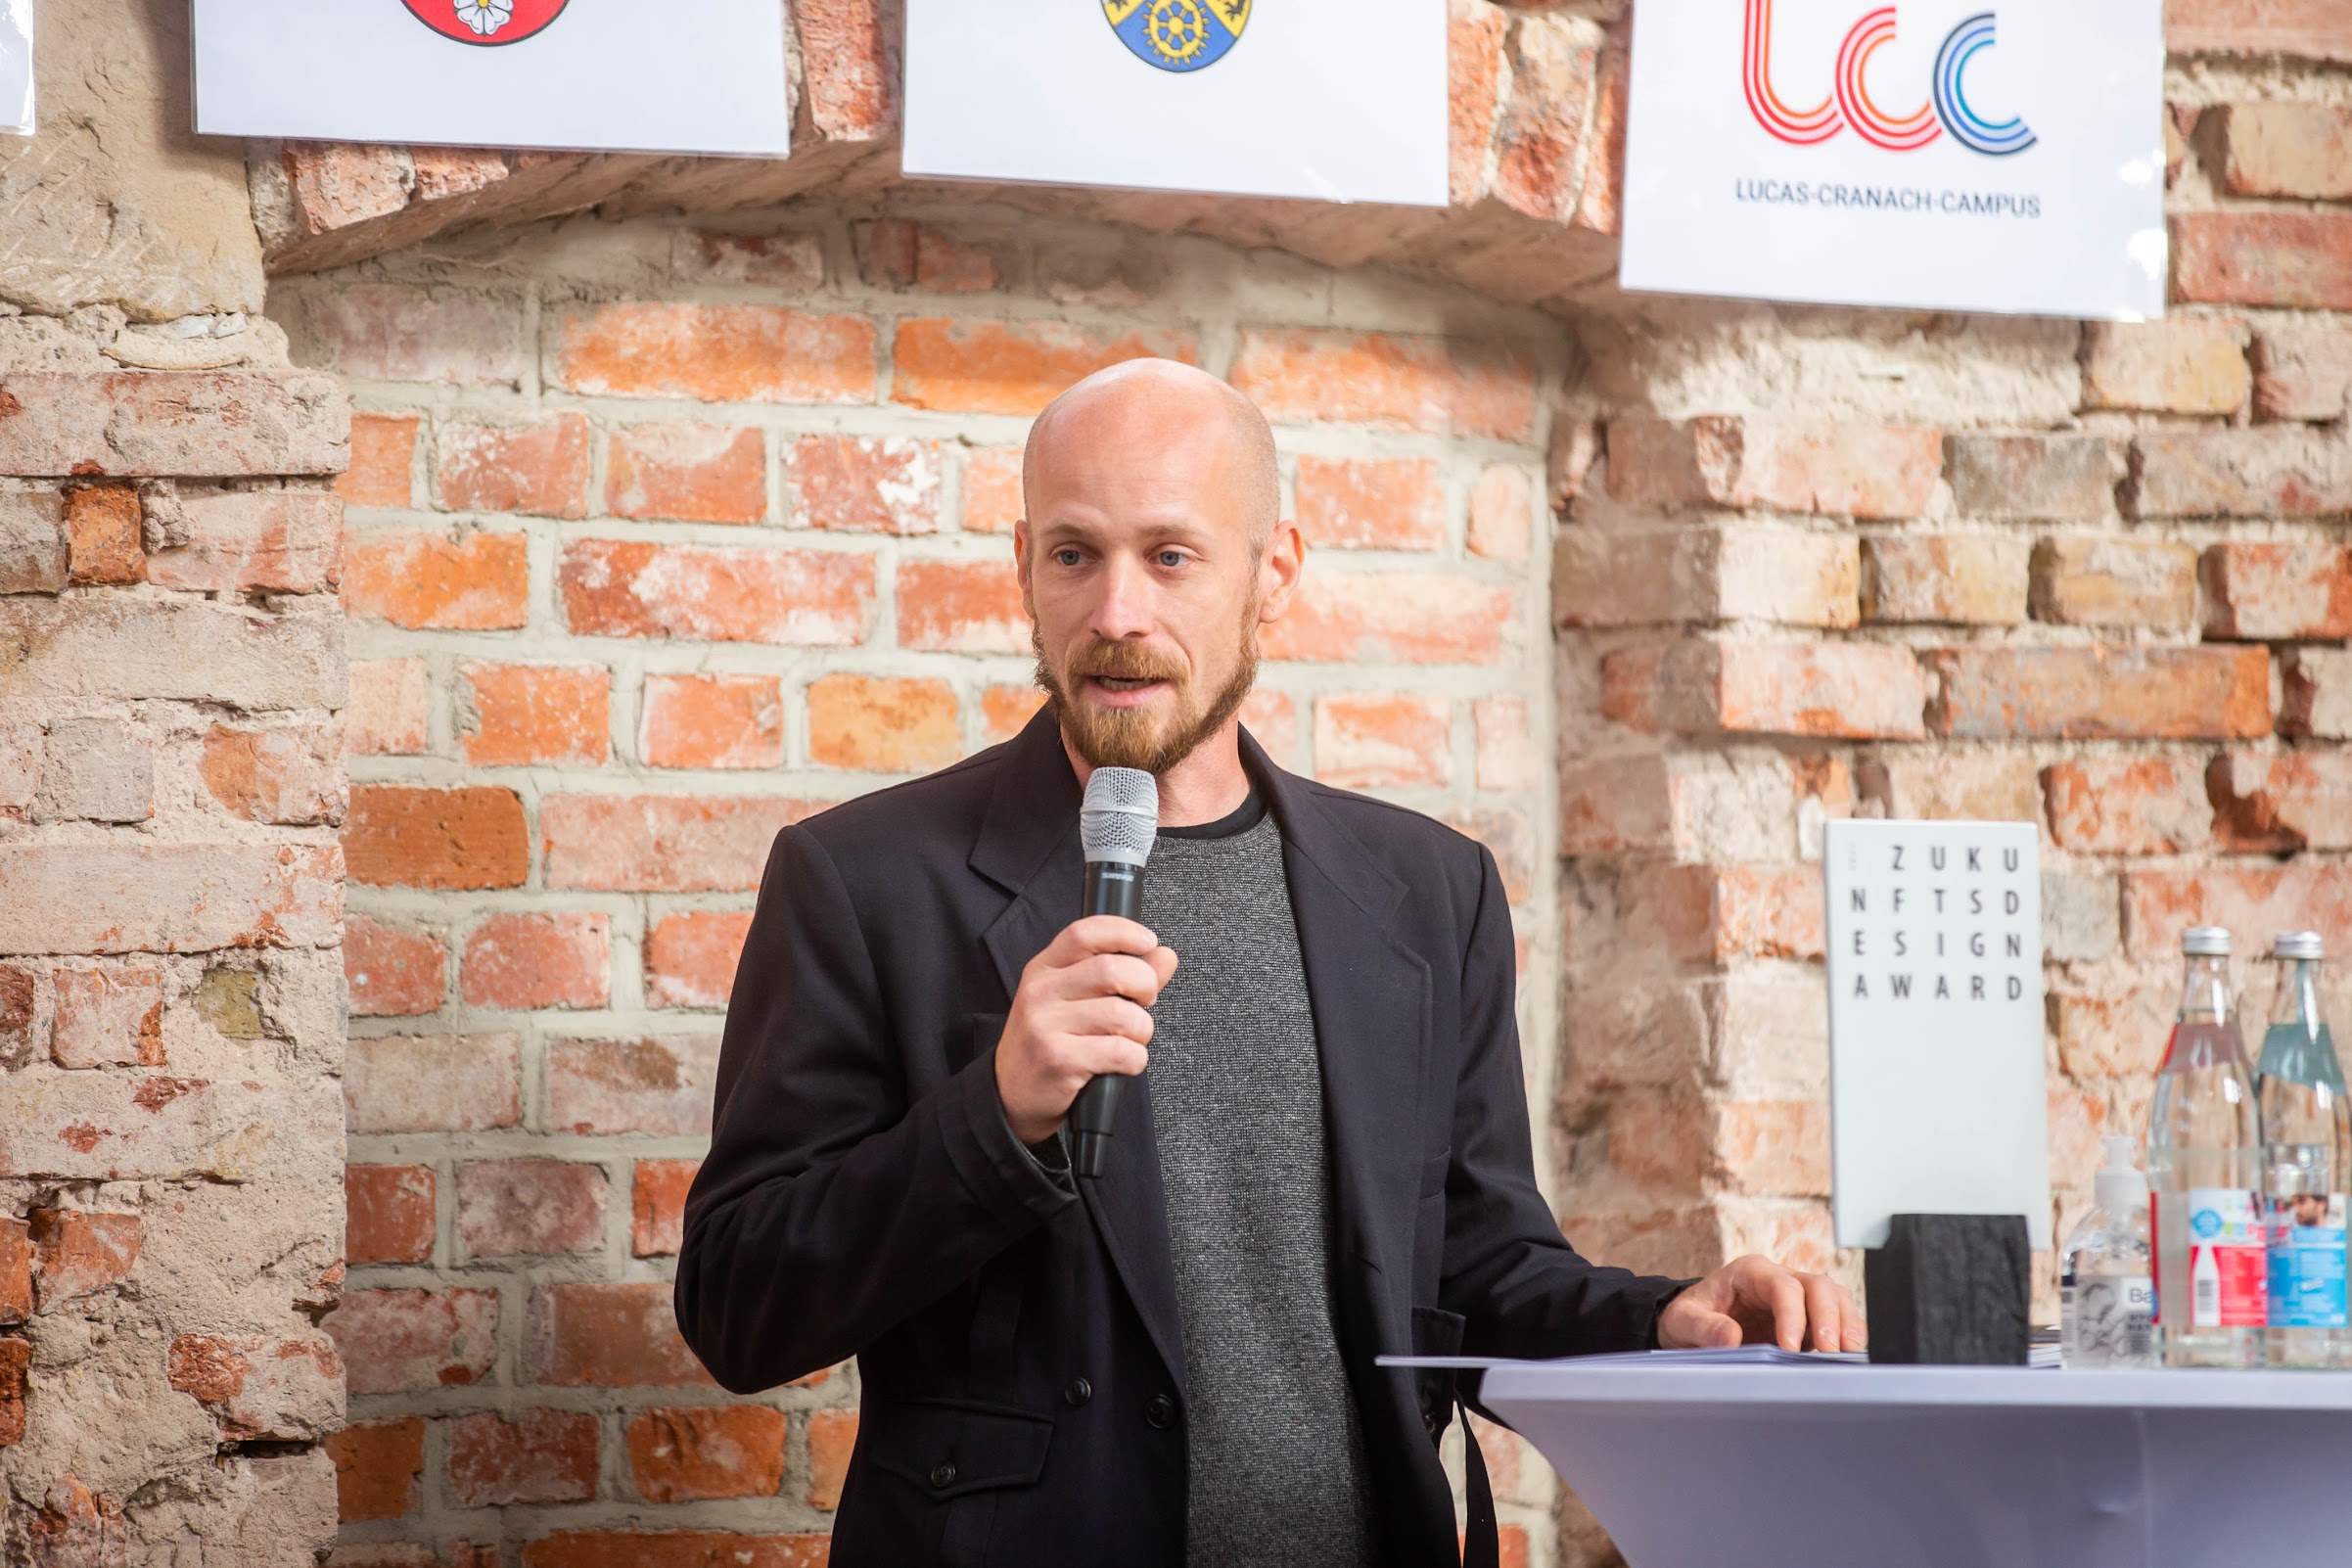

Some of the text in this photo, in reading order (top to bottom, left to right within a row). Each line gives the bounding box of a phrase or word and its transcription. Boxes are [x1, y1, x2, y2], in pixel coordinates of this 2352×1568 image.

[1735, 177, 2041, 217] LUCAS-CRANACH-CAMPUS
[1892, 845, 2019, 873] ZUKU
[1851, 888, 2020, 916] NFTSD
[1853, 930, 2021, 958] ESIGN
[1854, 974, 2023, 1001] AWARD
